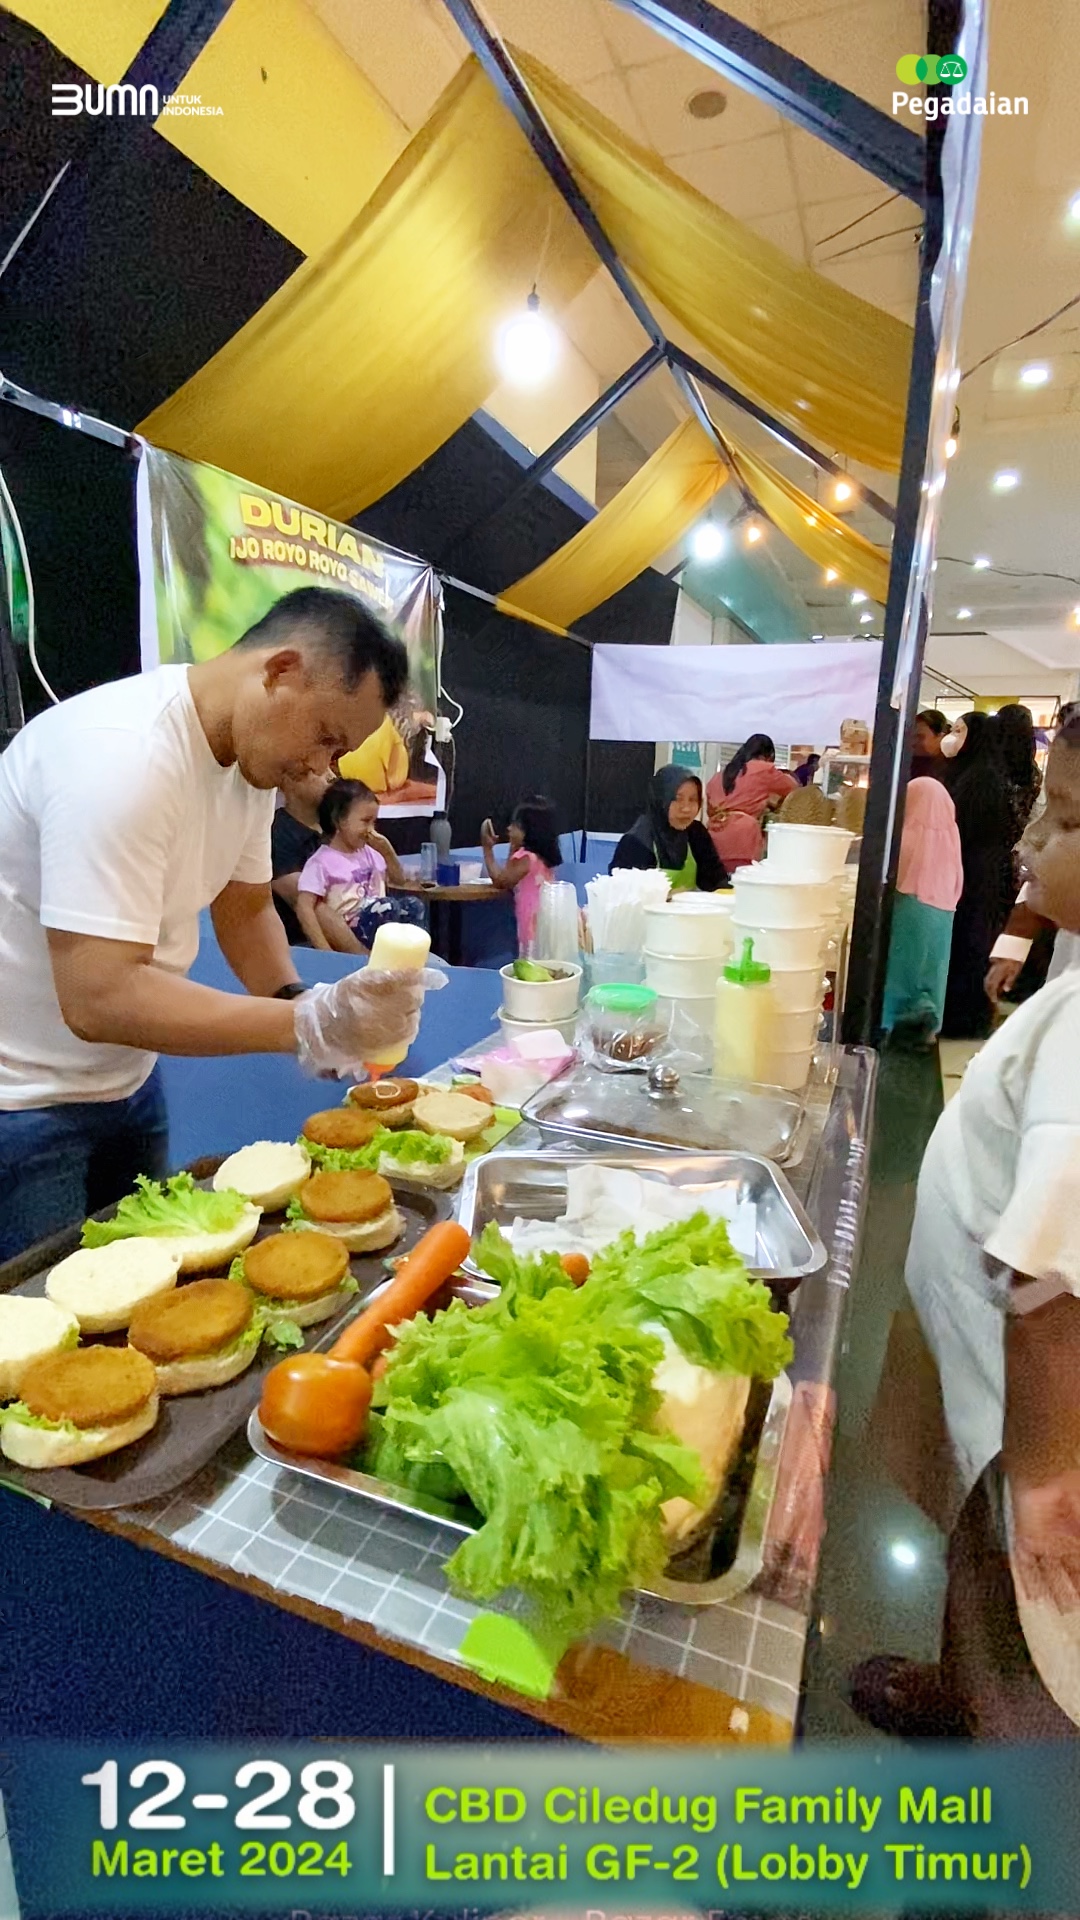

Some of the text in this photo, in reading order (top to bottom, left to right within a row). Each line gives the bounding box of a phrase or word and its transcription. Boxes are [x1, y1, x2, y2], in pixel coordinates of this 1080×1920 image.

[230, 537, 260, 559] IJO
[261, 538, 307, 566] ROYO
[308, 549, 348, 582] ROYO
[240, 493, 384, 578] DURIAN
